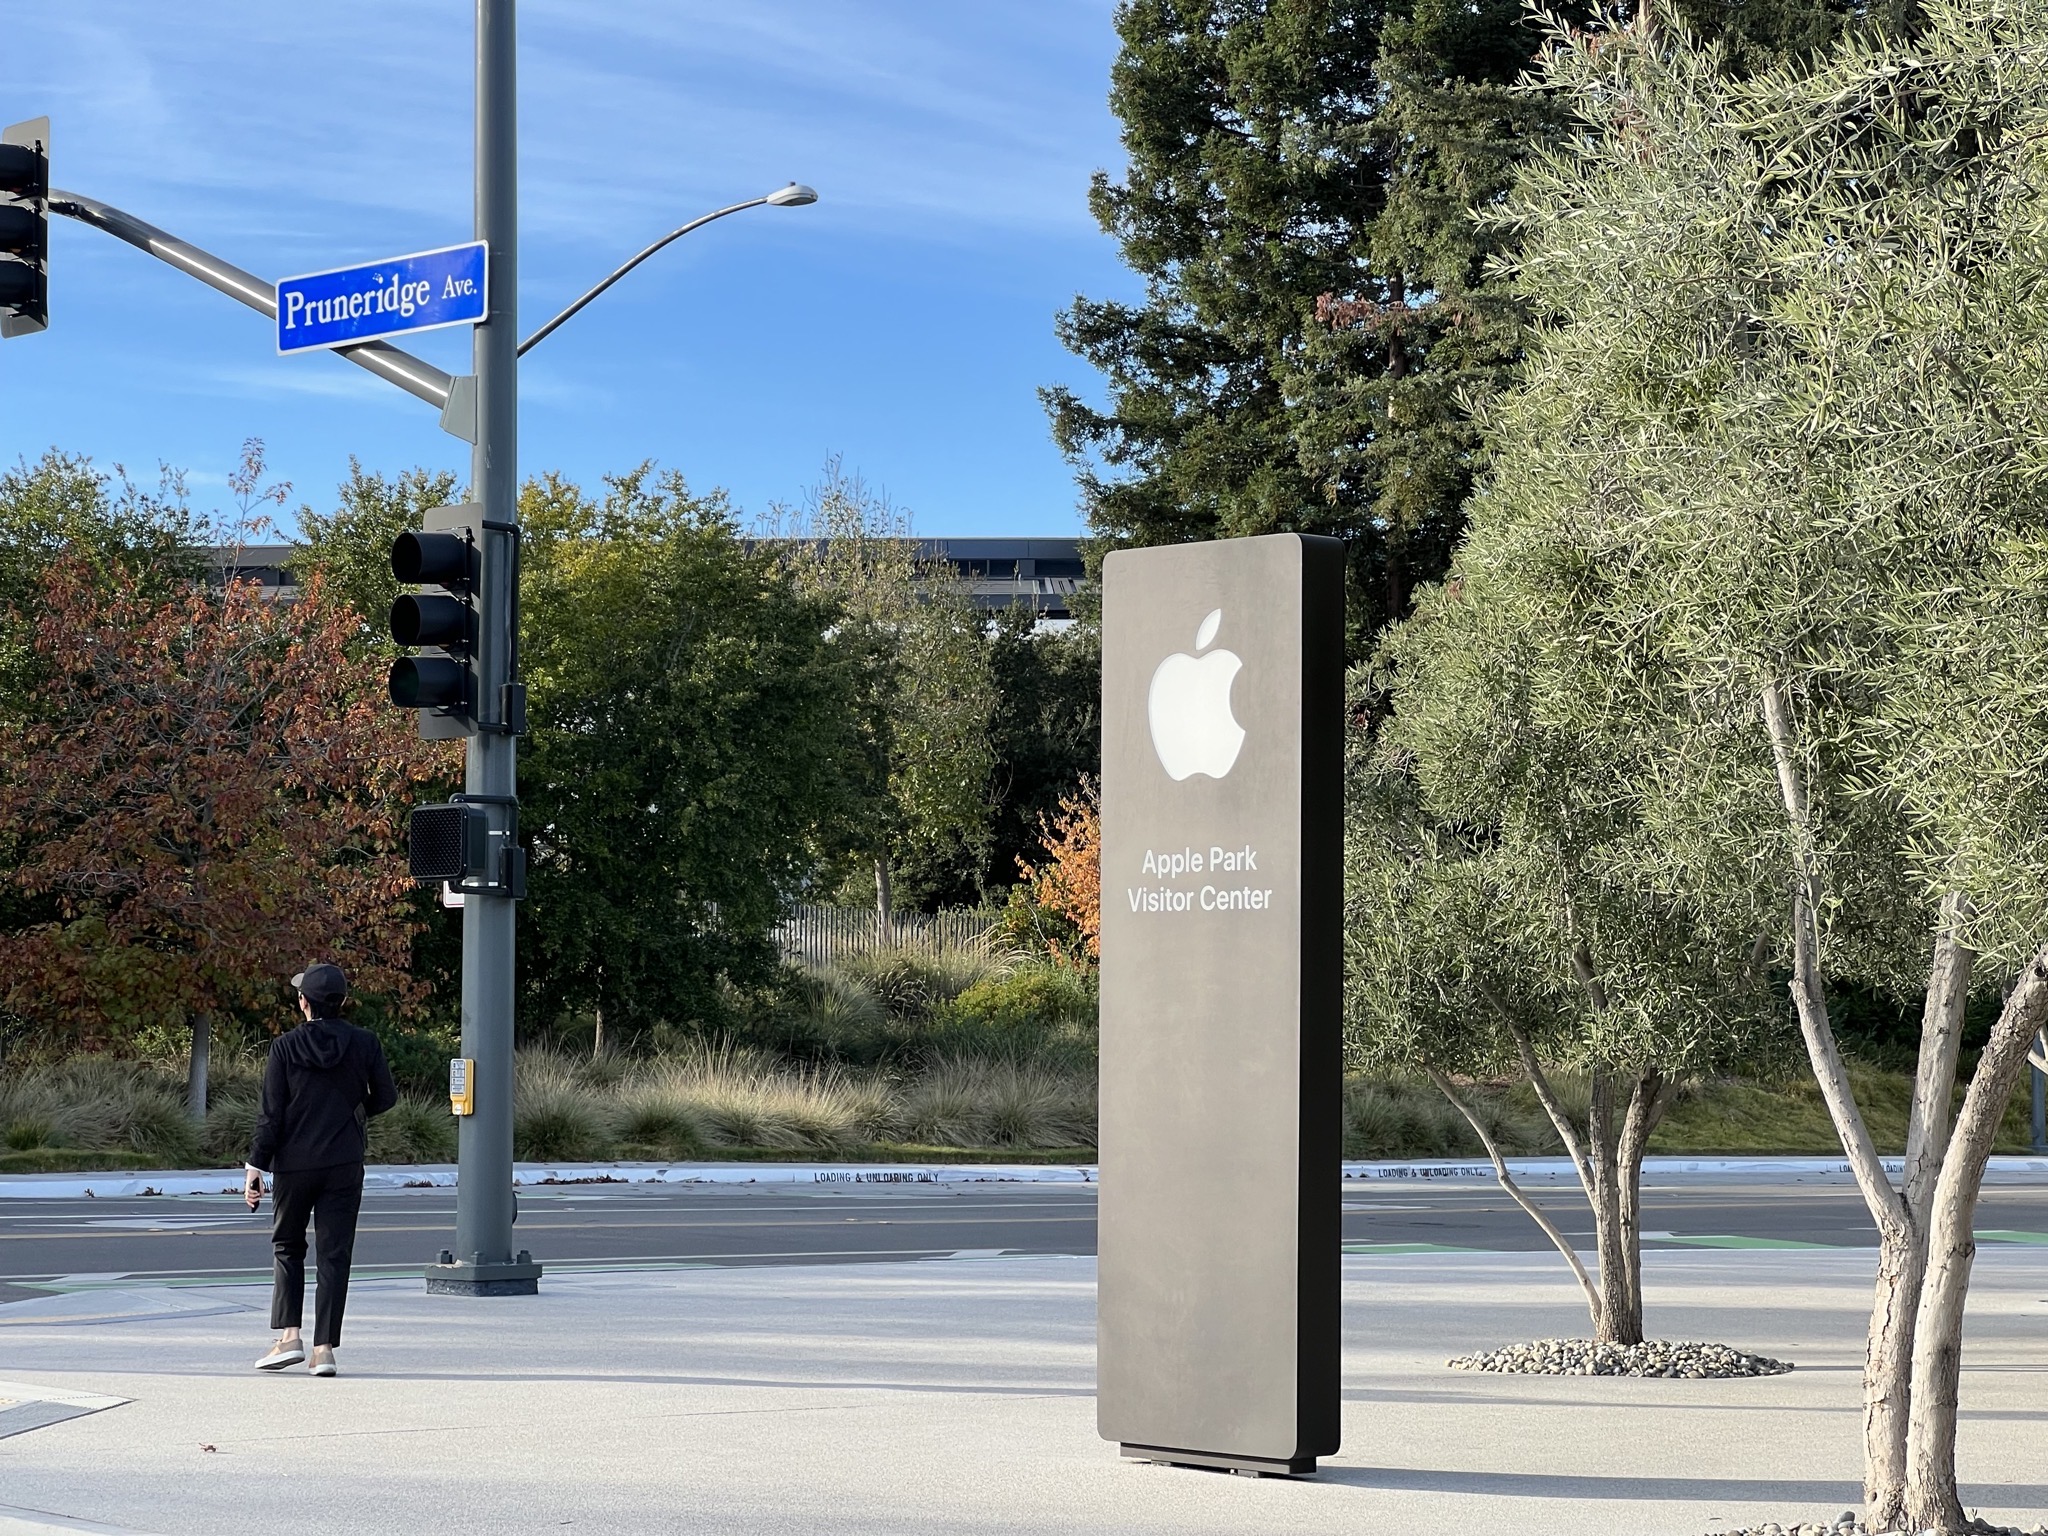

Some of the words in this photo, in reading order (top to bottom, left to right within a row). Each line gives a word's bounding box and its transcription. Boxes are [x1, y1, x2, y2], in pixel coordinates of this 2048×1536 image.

[284, 272, 430, 330] Pruneridge
[442, 274, 478, 299] Ave.
[1142, 847, 1204, 879] Apple
[1209, 845, 1258, 872] Park
[1127, 886, 1195, 912] Visitor
[1200, 885, 1273, 911] Center
[814, 1172, 851, 1183] LOADING
[855, 1173, 863, 1182] &
[866, 1172, 914, 1183] UNLOADING
[917, 1173, 939, 1183] ONLY
[1378, 1168, 1408, 1178] LOADING
[1461, 1167, 1478, 1176] ONLY
